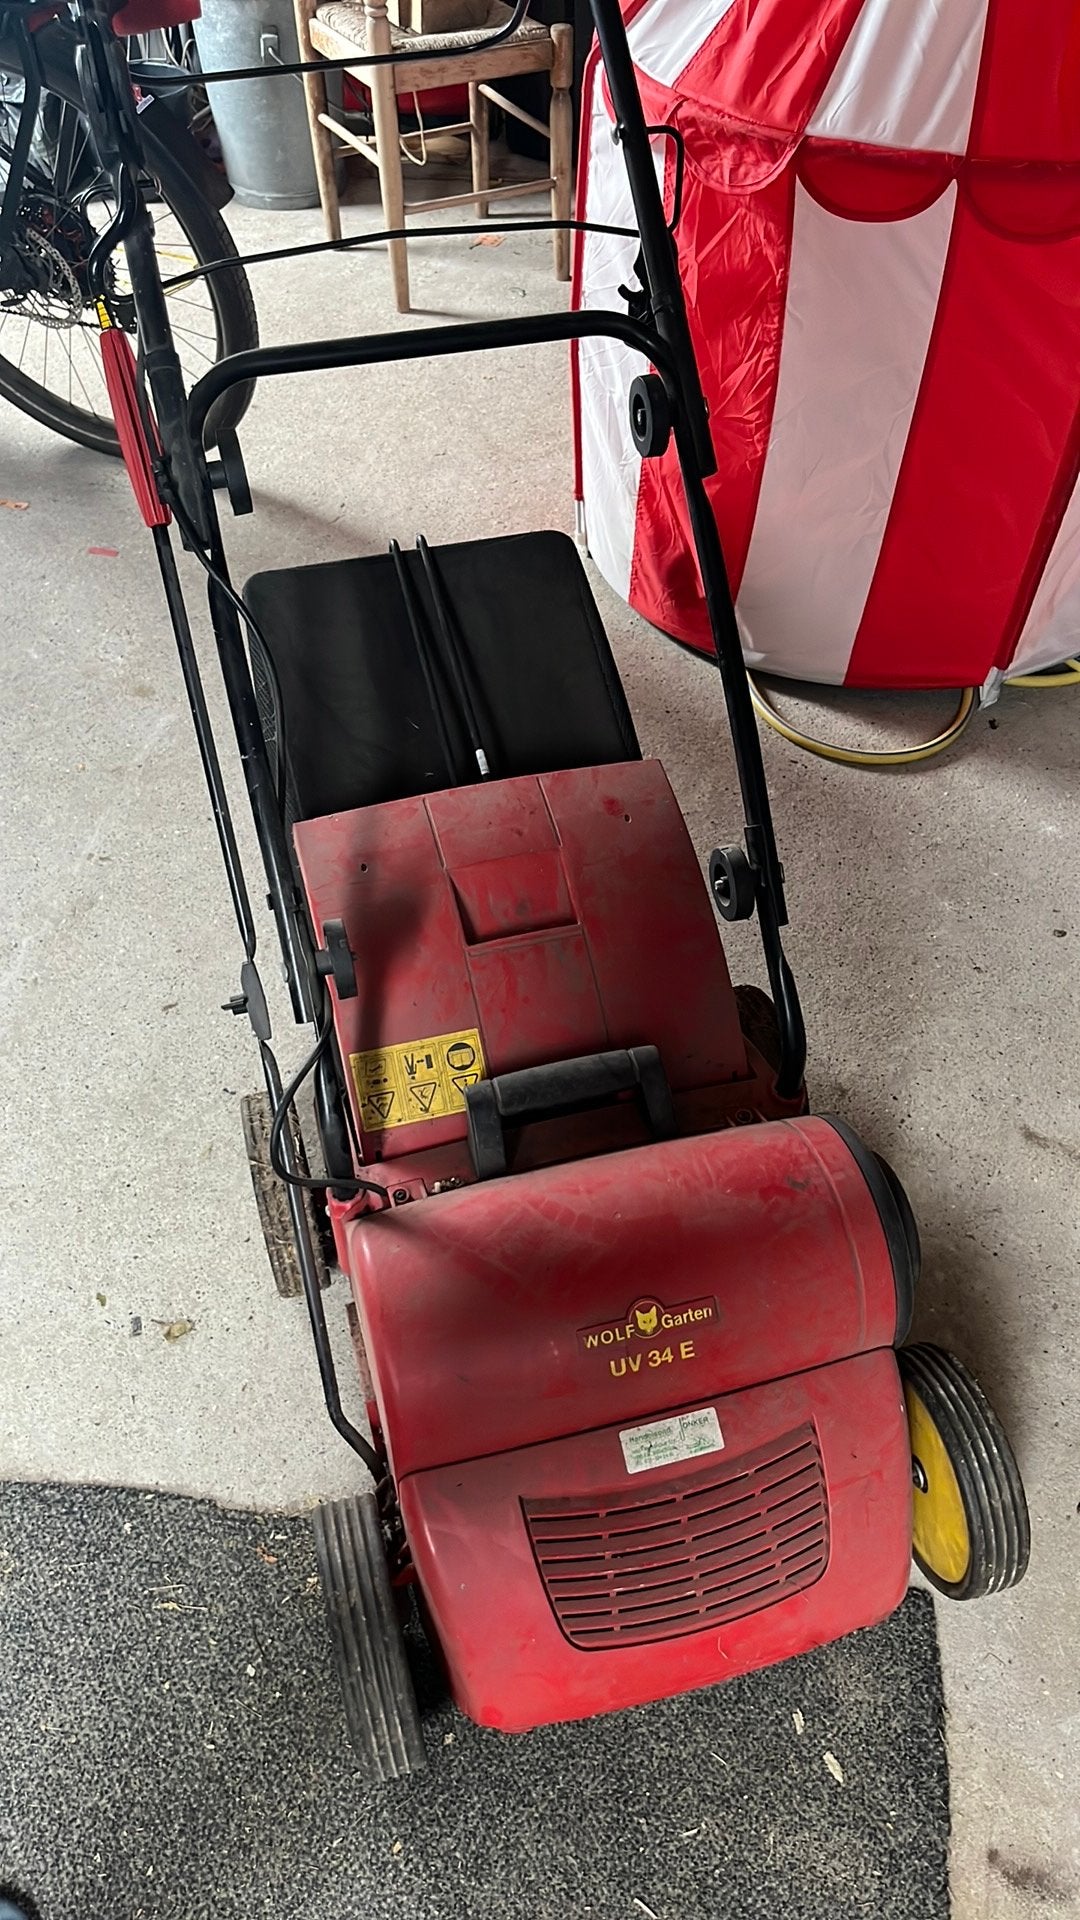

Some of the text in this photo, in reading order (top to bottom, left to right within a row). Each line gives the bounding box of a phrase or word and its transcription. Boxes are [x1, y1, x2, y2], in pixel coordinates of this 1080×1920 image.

[584, 1307, 712, 1348] WOLF Garten
[610, 1340, 695, 1376] UV 34 E
